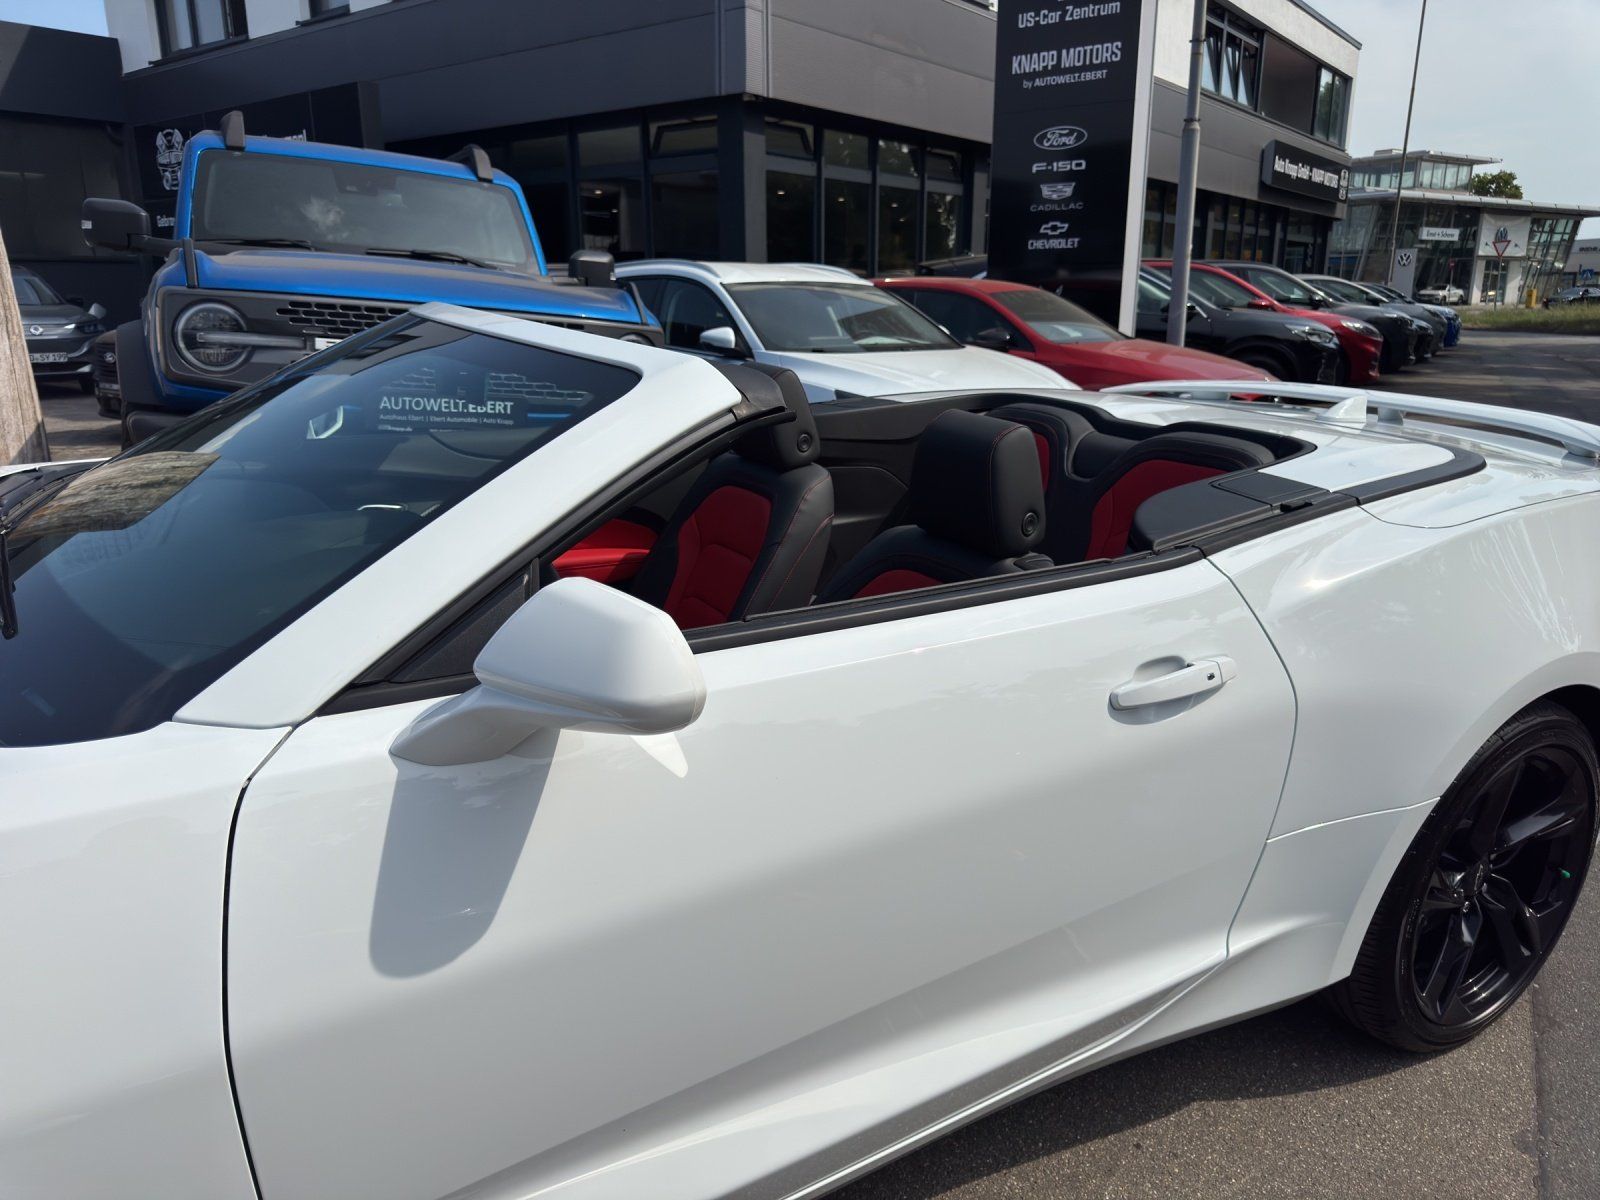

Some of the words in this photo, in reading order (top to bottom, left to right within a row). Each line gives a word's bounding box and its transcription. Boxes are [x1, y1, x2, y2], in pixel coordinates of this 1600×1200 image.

[1018, 9, 1062, 28] US-Car
[1065, 1, 1121, 21] Zentrum
[1012, 50, 1057, 75] KNAPP
[1061, 42, 1122, 69] MOTORS
[1023, 79, 1033, 89] by
[1034, 70, 1108, 87] AUTOWELT.EBERT
[1042, 128, 1078, 147] Ford
[1032, 160, 1086, 173] F-150
[1030, 202, 1084, 212] CADILLAC
[1028, 238, 1080, 250] CHEVROLET
[379, 396, 515, 414] AUTOWELT.EBERT
